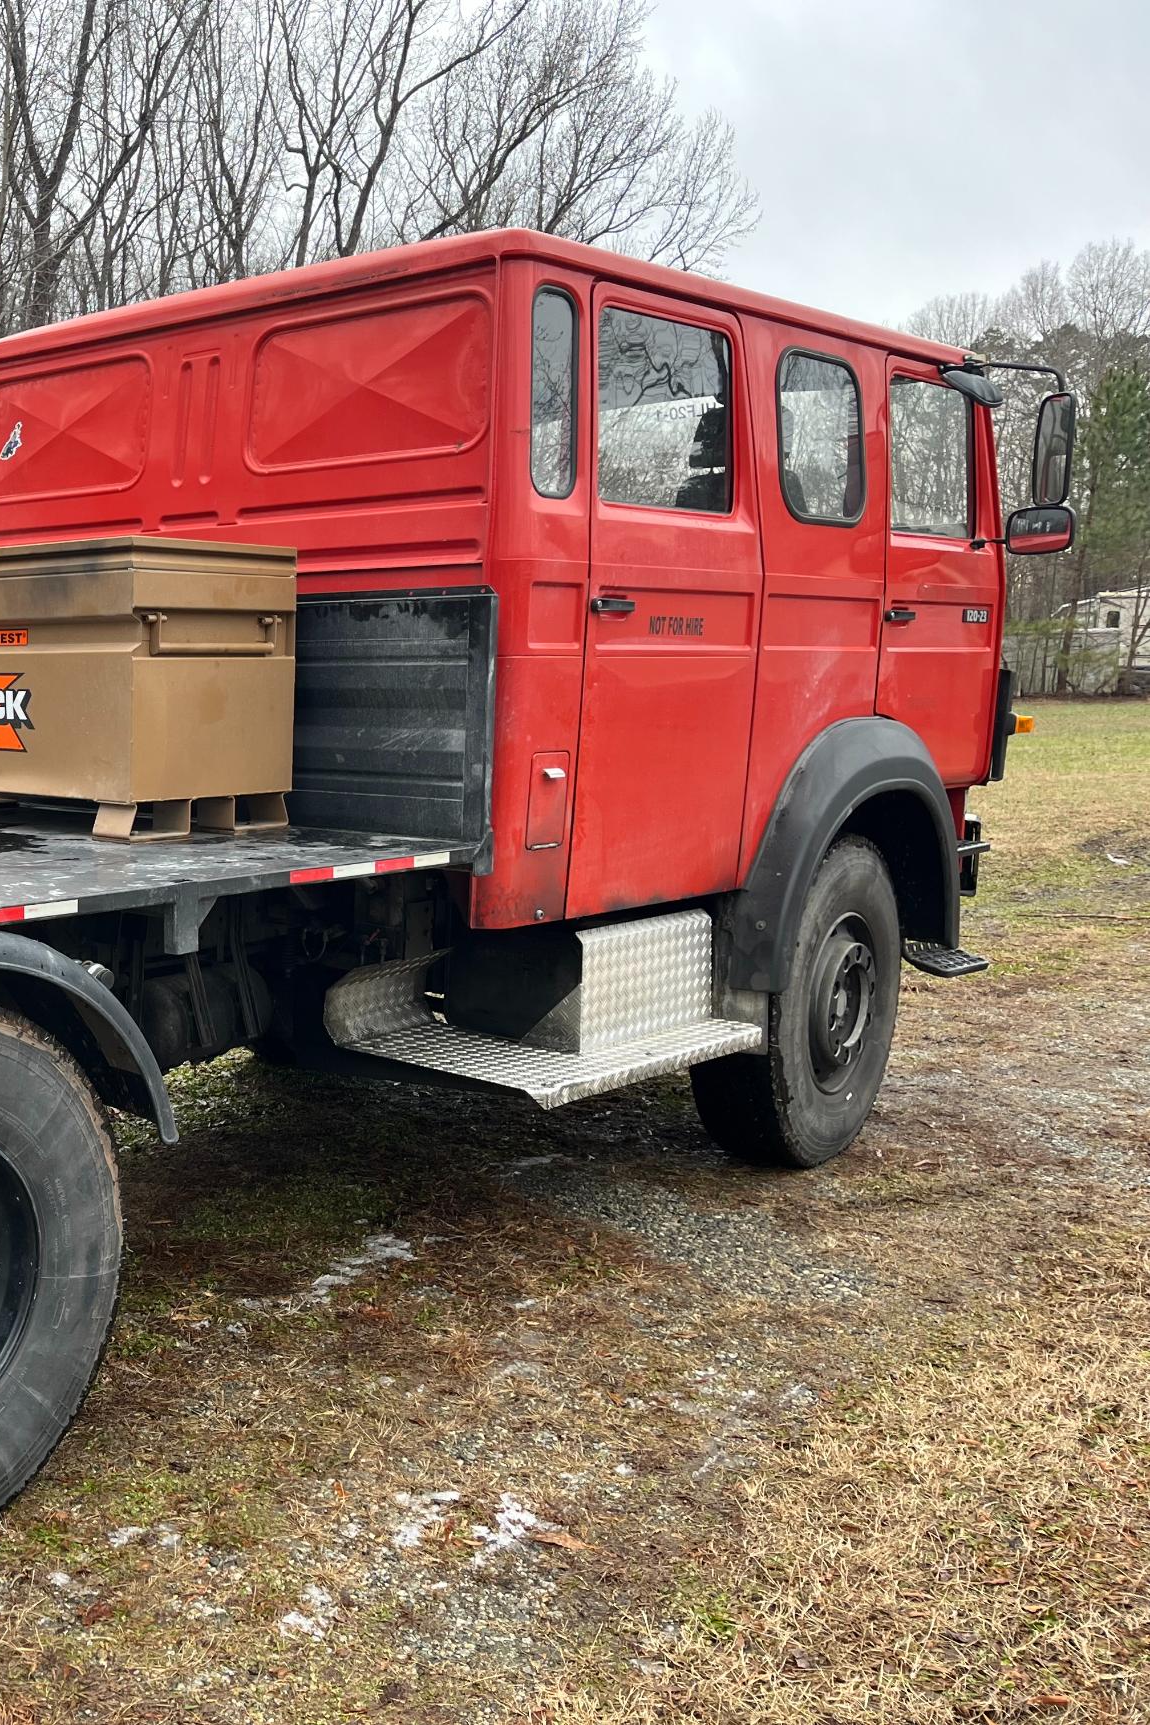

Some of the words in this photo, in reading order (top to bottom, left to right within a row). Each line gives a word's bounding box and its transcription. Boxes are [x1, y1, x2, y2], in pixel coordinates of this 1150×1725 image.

[966, 609, 988, 623] 120-23
[649, 615, 667, 635] NOT
[668, 616, 684, 636] FOR
[685, 617, 704, 636] HIRE
